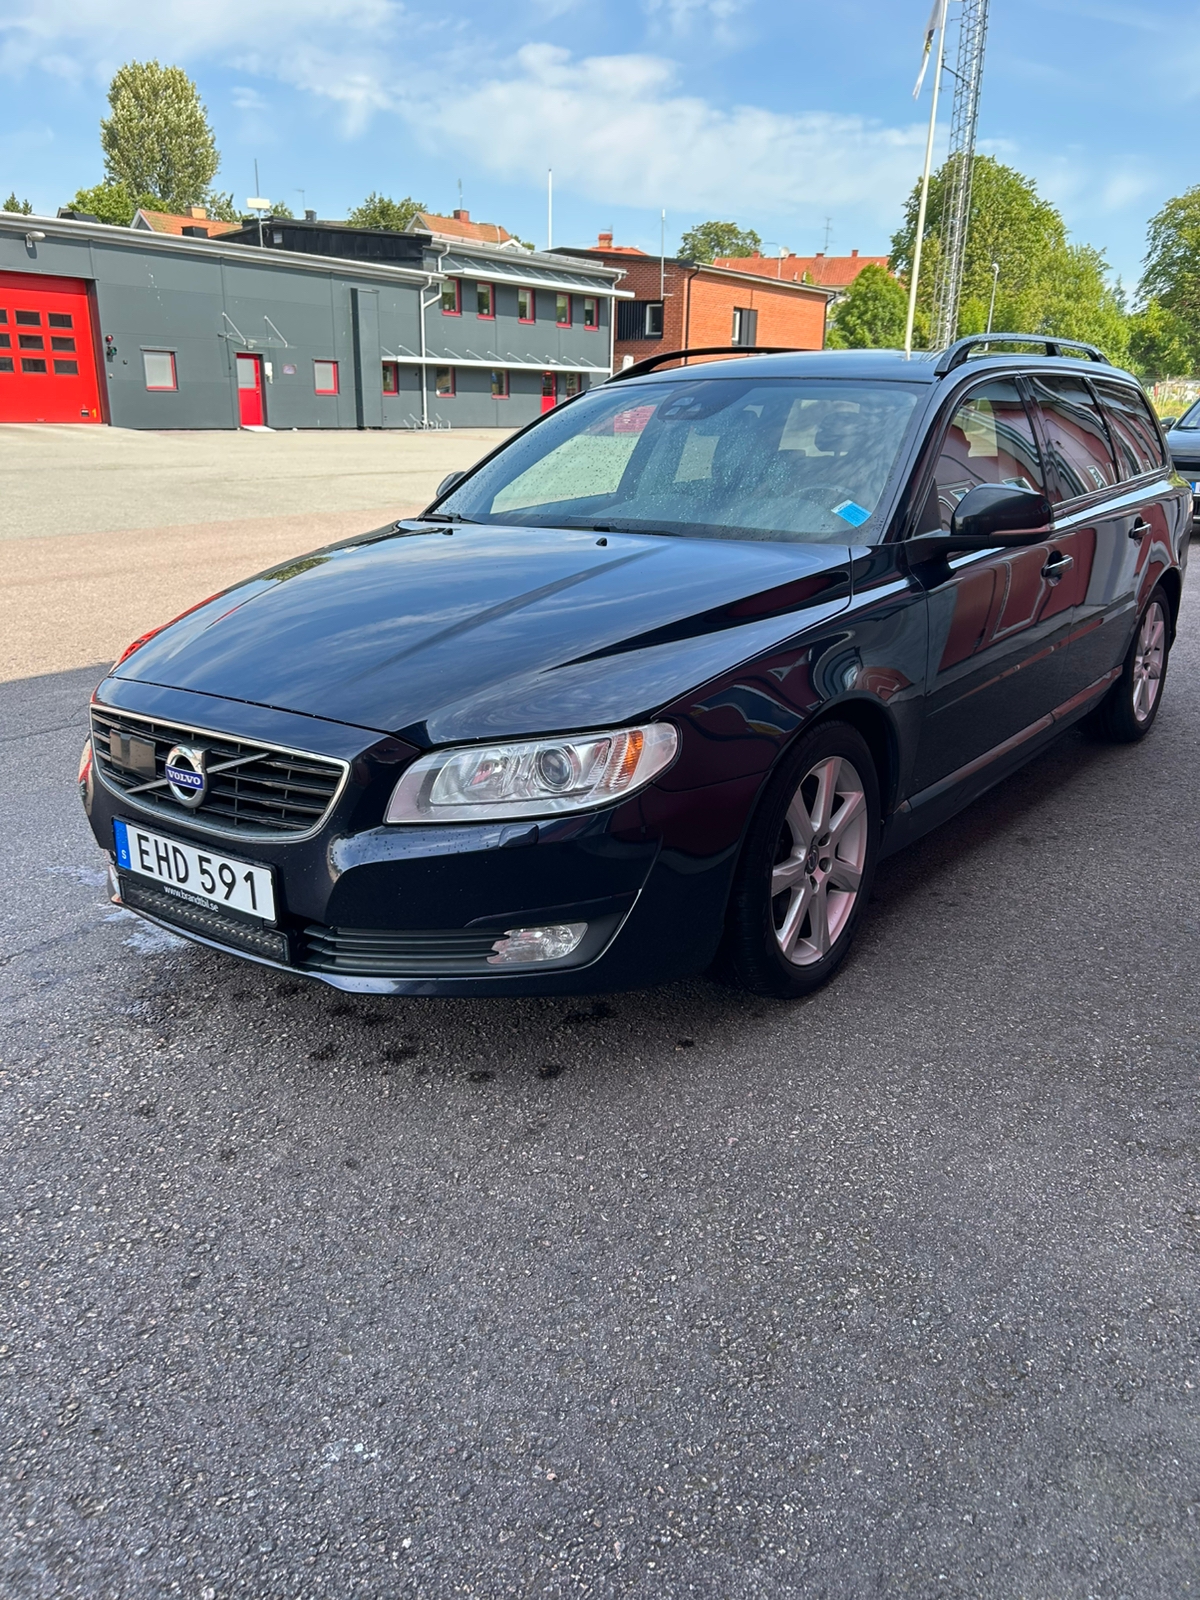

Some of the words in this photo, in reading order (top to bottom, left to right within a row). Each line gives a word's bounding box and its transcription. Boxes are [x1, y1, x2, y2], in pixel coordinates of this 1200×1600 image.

[91, 407, 97, 419] 1
[167, 769, 201, 785] VOLVO
[121, 849, 127, 860] S
[136, 833, 189, 884] EHD
[197, 854, 257, 911] 591
